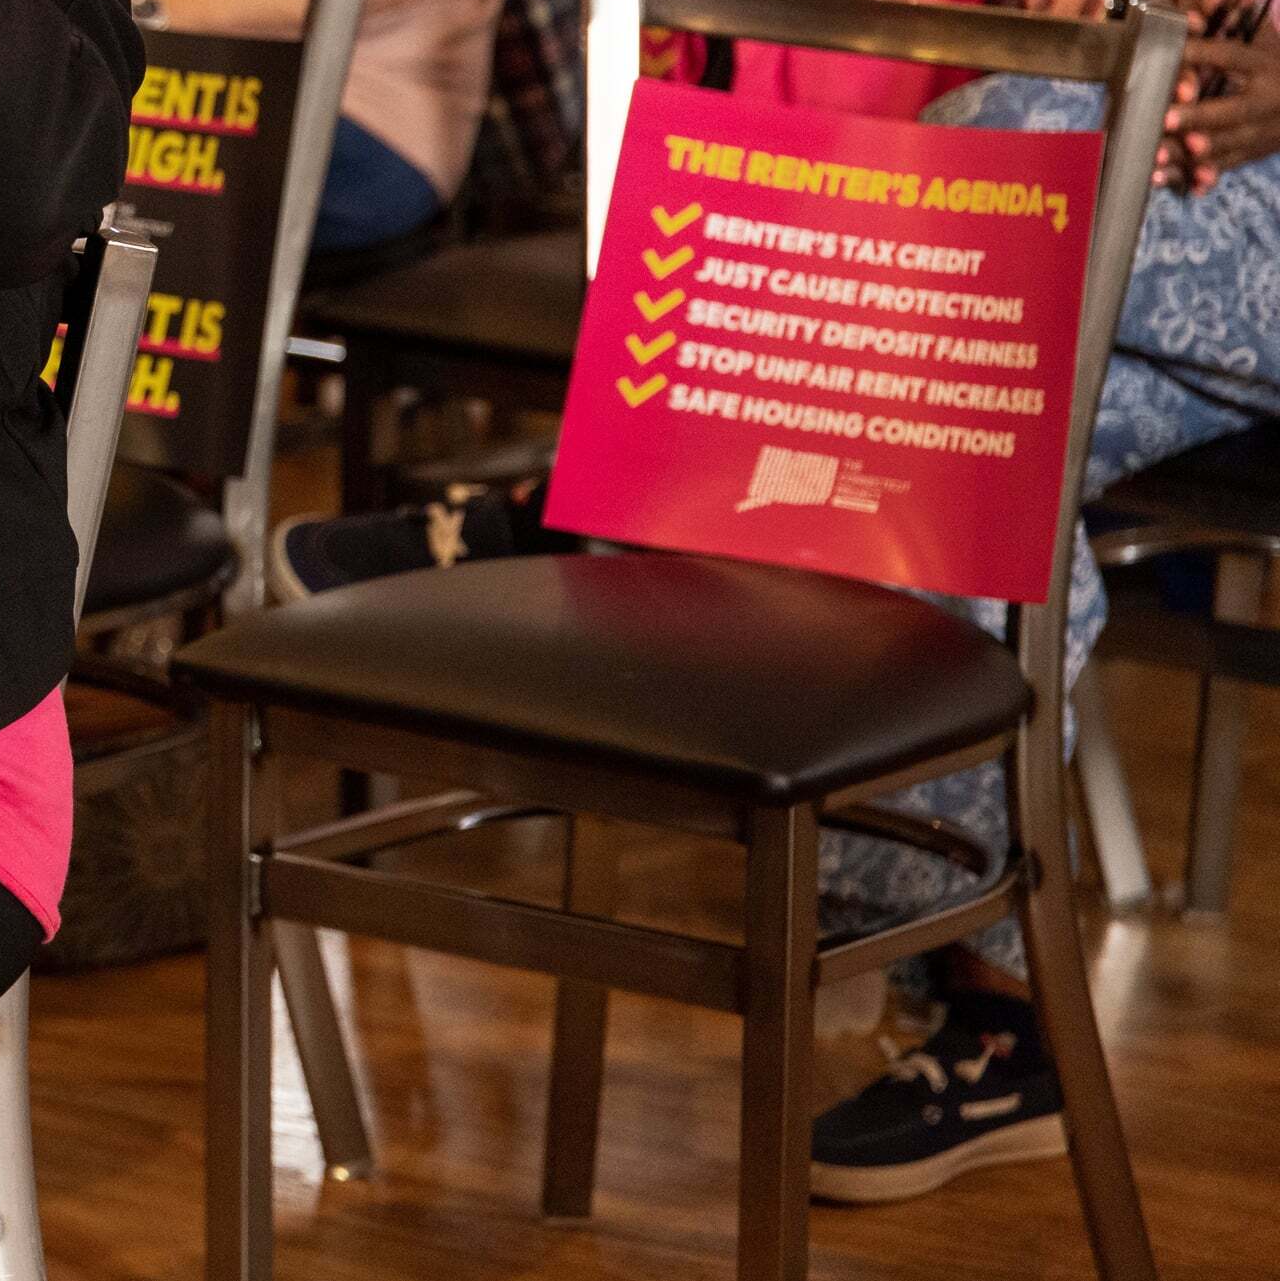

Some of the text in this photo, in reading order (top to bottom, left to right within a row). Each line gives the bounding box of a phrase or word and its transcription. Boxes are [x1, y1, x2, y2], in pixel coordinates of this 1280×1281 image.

[132, 66, 263, 129] ENT IS
[664, 134, 1044, 217] THE RENTER'S AGENDA
[704, 212, 986, 277] RENTER'S TAX CREDIT
[694, 256, 1024, 324] JUST CAUSE PROTECTIONS
[686, 297, 1038, 370] SECURITY DEPOSIT FAIRNESS
[677, 340, 1045, 415] STOP UNFAIR RENT INCREASES
[668, 383, 1016, 458] SAFE HOUSING CONDITIONS
